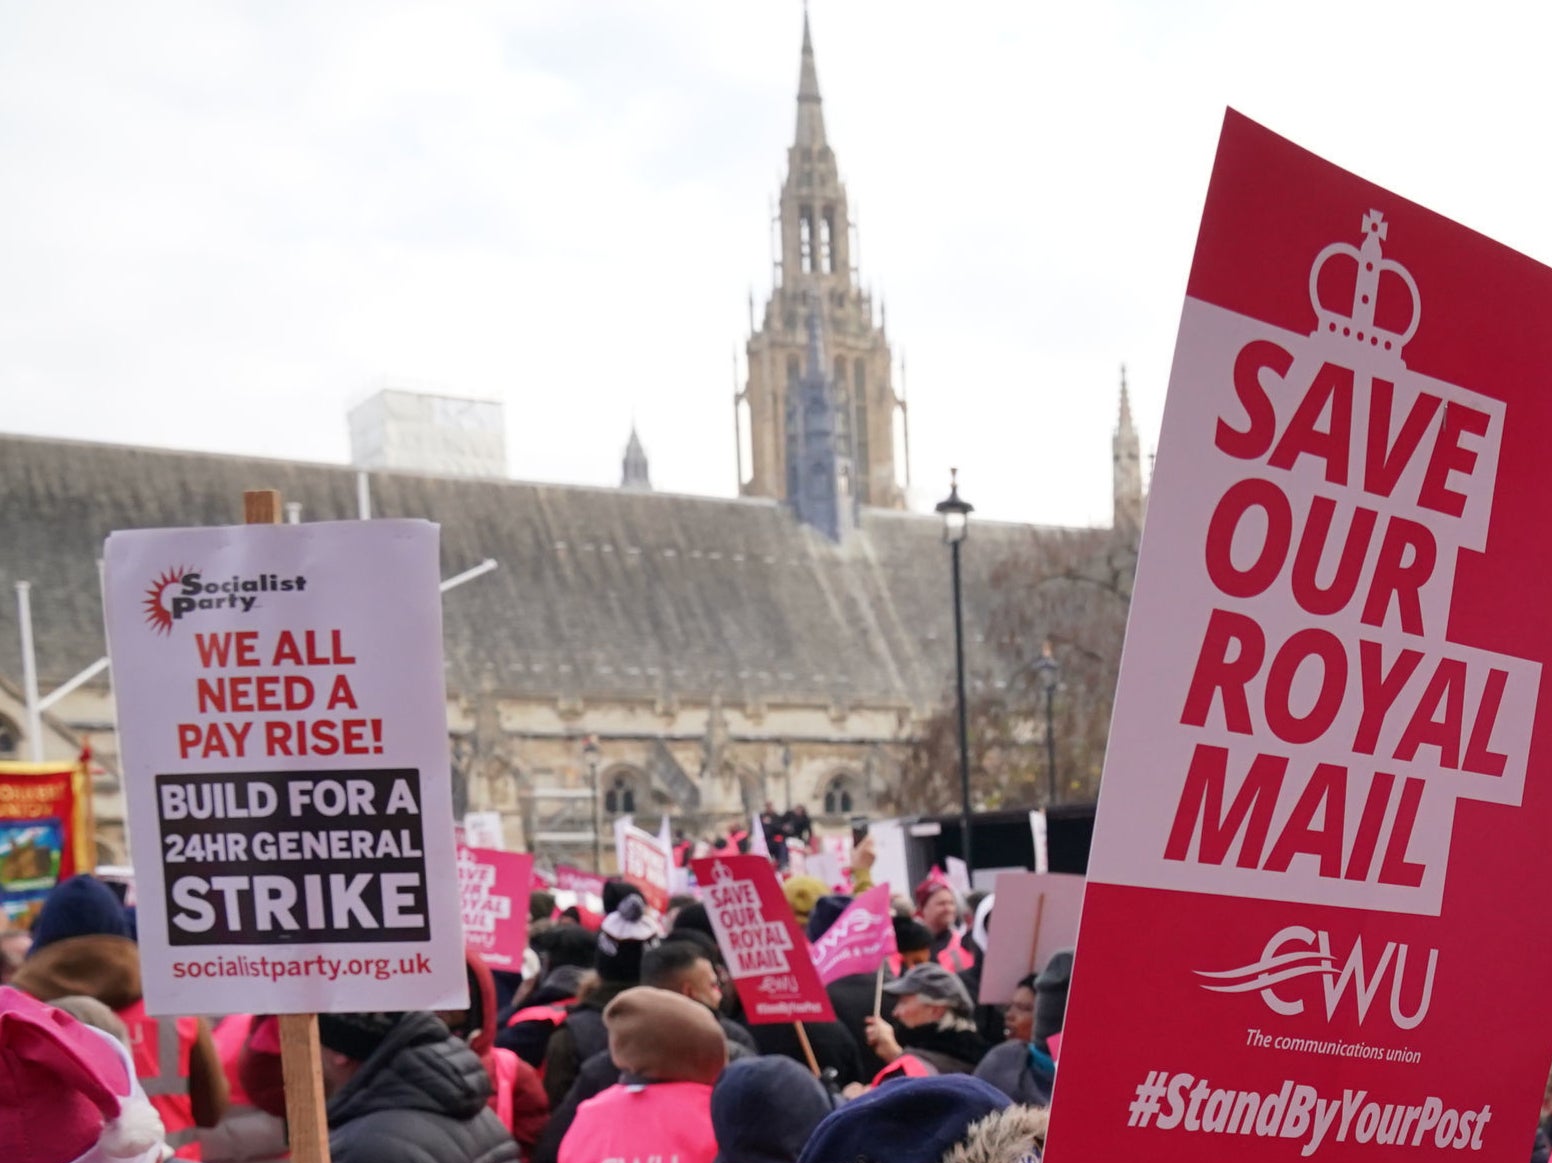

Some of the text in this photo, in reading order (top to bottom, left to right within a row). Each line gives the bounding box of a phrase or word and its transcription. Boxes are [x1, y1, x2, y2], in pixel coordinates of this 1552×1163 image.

[1214, 340, 1491, 518] SAVE
[1205, 478, 1437, 637] OUR
[181, 573, 307, 595] Socialist
[172, 594, 256, 619] Party
[195, 629, 356, 668] WE ALL
[197, 674, 358, 713] NEED A
[1179, 607, 1509, 778] ROYAL
[177, 718, 384, 759] PAY RISE!
[160, 779, 419, 820] BUILD FOR A
[1163, 743, 1426, 888] MAIL
[164, 829, 423, 863] 24HR GENERAL
[172, 872, 425, 933] STRIKE
[710, 885, 755, 908] SAVE
[719, 909, 758, 929] OUR
[728, 926, 786, 948] ROYAL
[173, 952, 433, 982] socialistparty.org.uk
[738, 949, 784, 971] MAIL
[1192, 925, 1439, 1030] CWU
[1246, 1029, 1421, 1064] The communications union
[1127, 1070, 1492, 1157] #StandByYourPost
